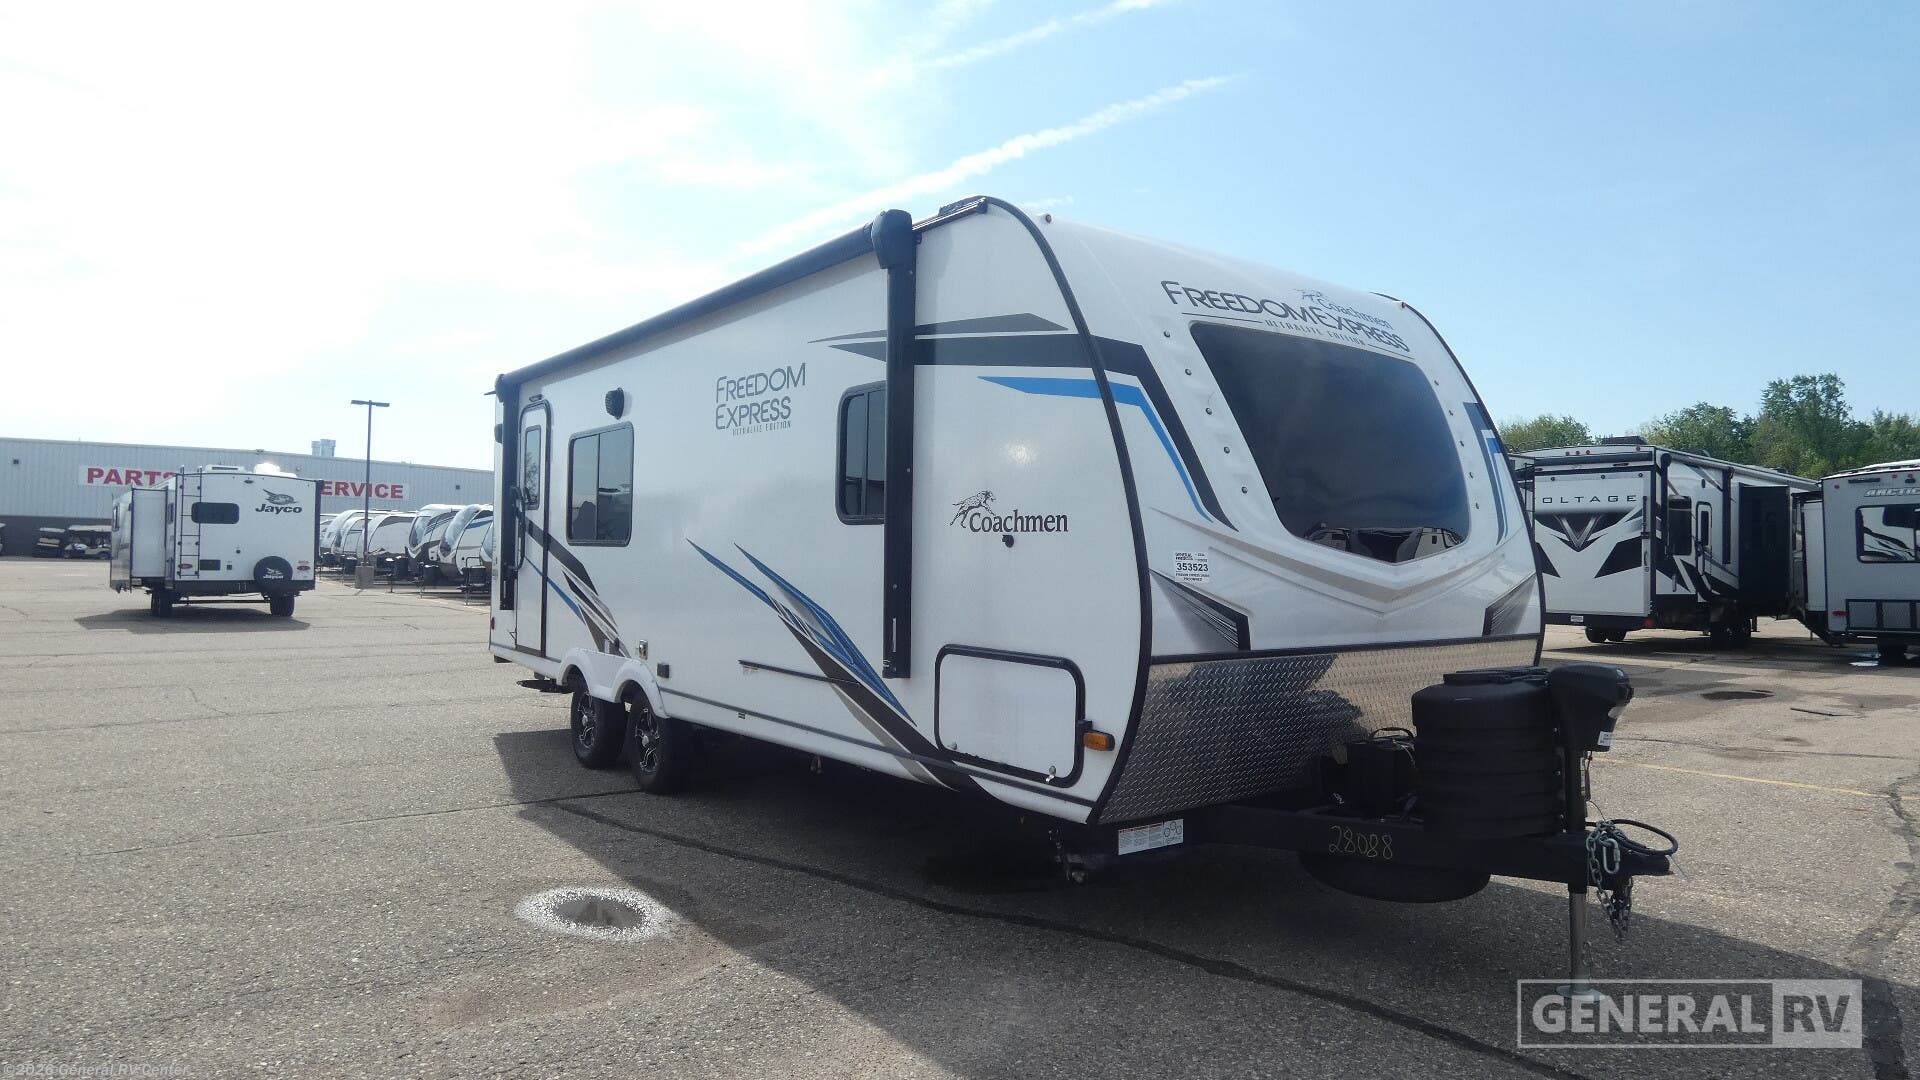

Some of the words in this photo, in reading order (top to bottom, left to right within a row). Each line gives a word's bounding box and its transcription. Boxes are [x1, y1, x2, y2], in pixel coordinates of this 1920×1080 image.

[1316, 298, 1394, 330] Coachmen
[716, 362, 806, 403] FREEDOM
[715, 396, 792, 430] EXPRESS
[320, 480, 404, 499] ERVICE
[255, 503, 303, 515] Jayco
[969, 508, 1069, 533] Coachmen
[1176, 562, 1209, 572] 353523
[1328, 825, 1393, 860] 28088
